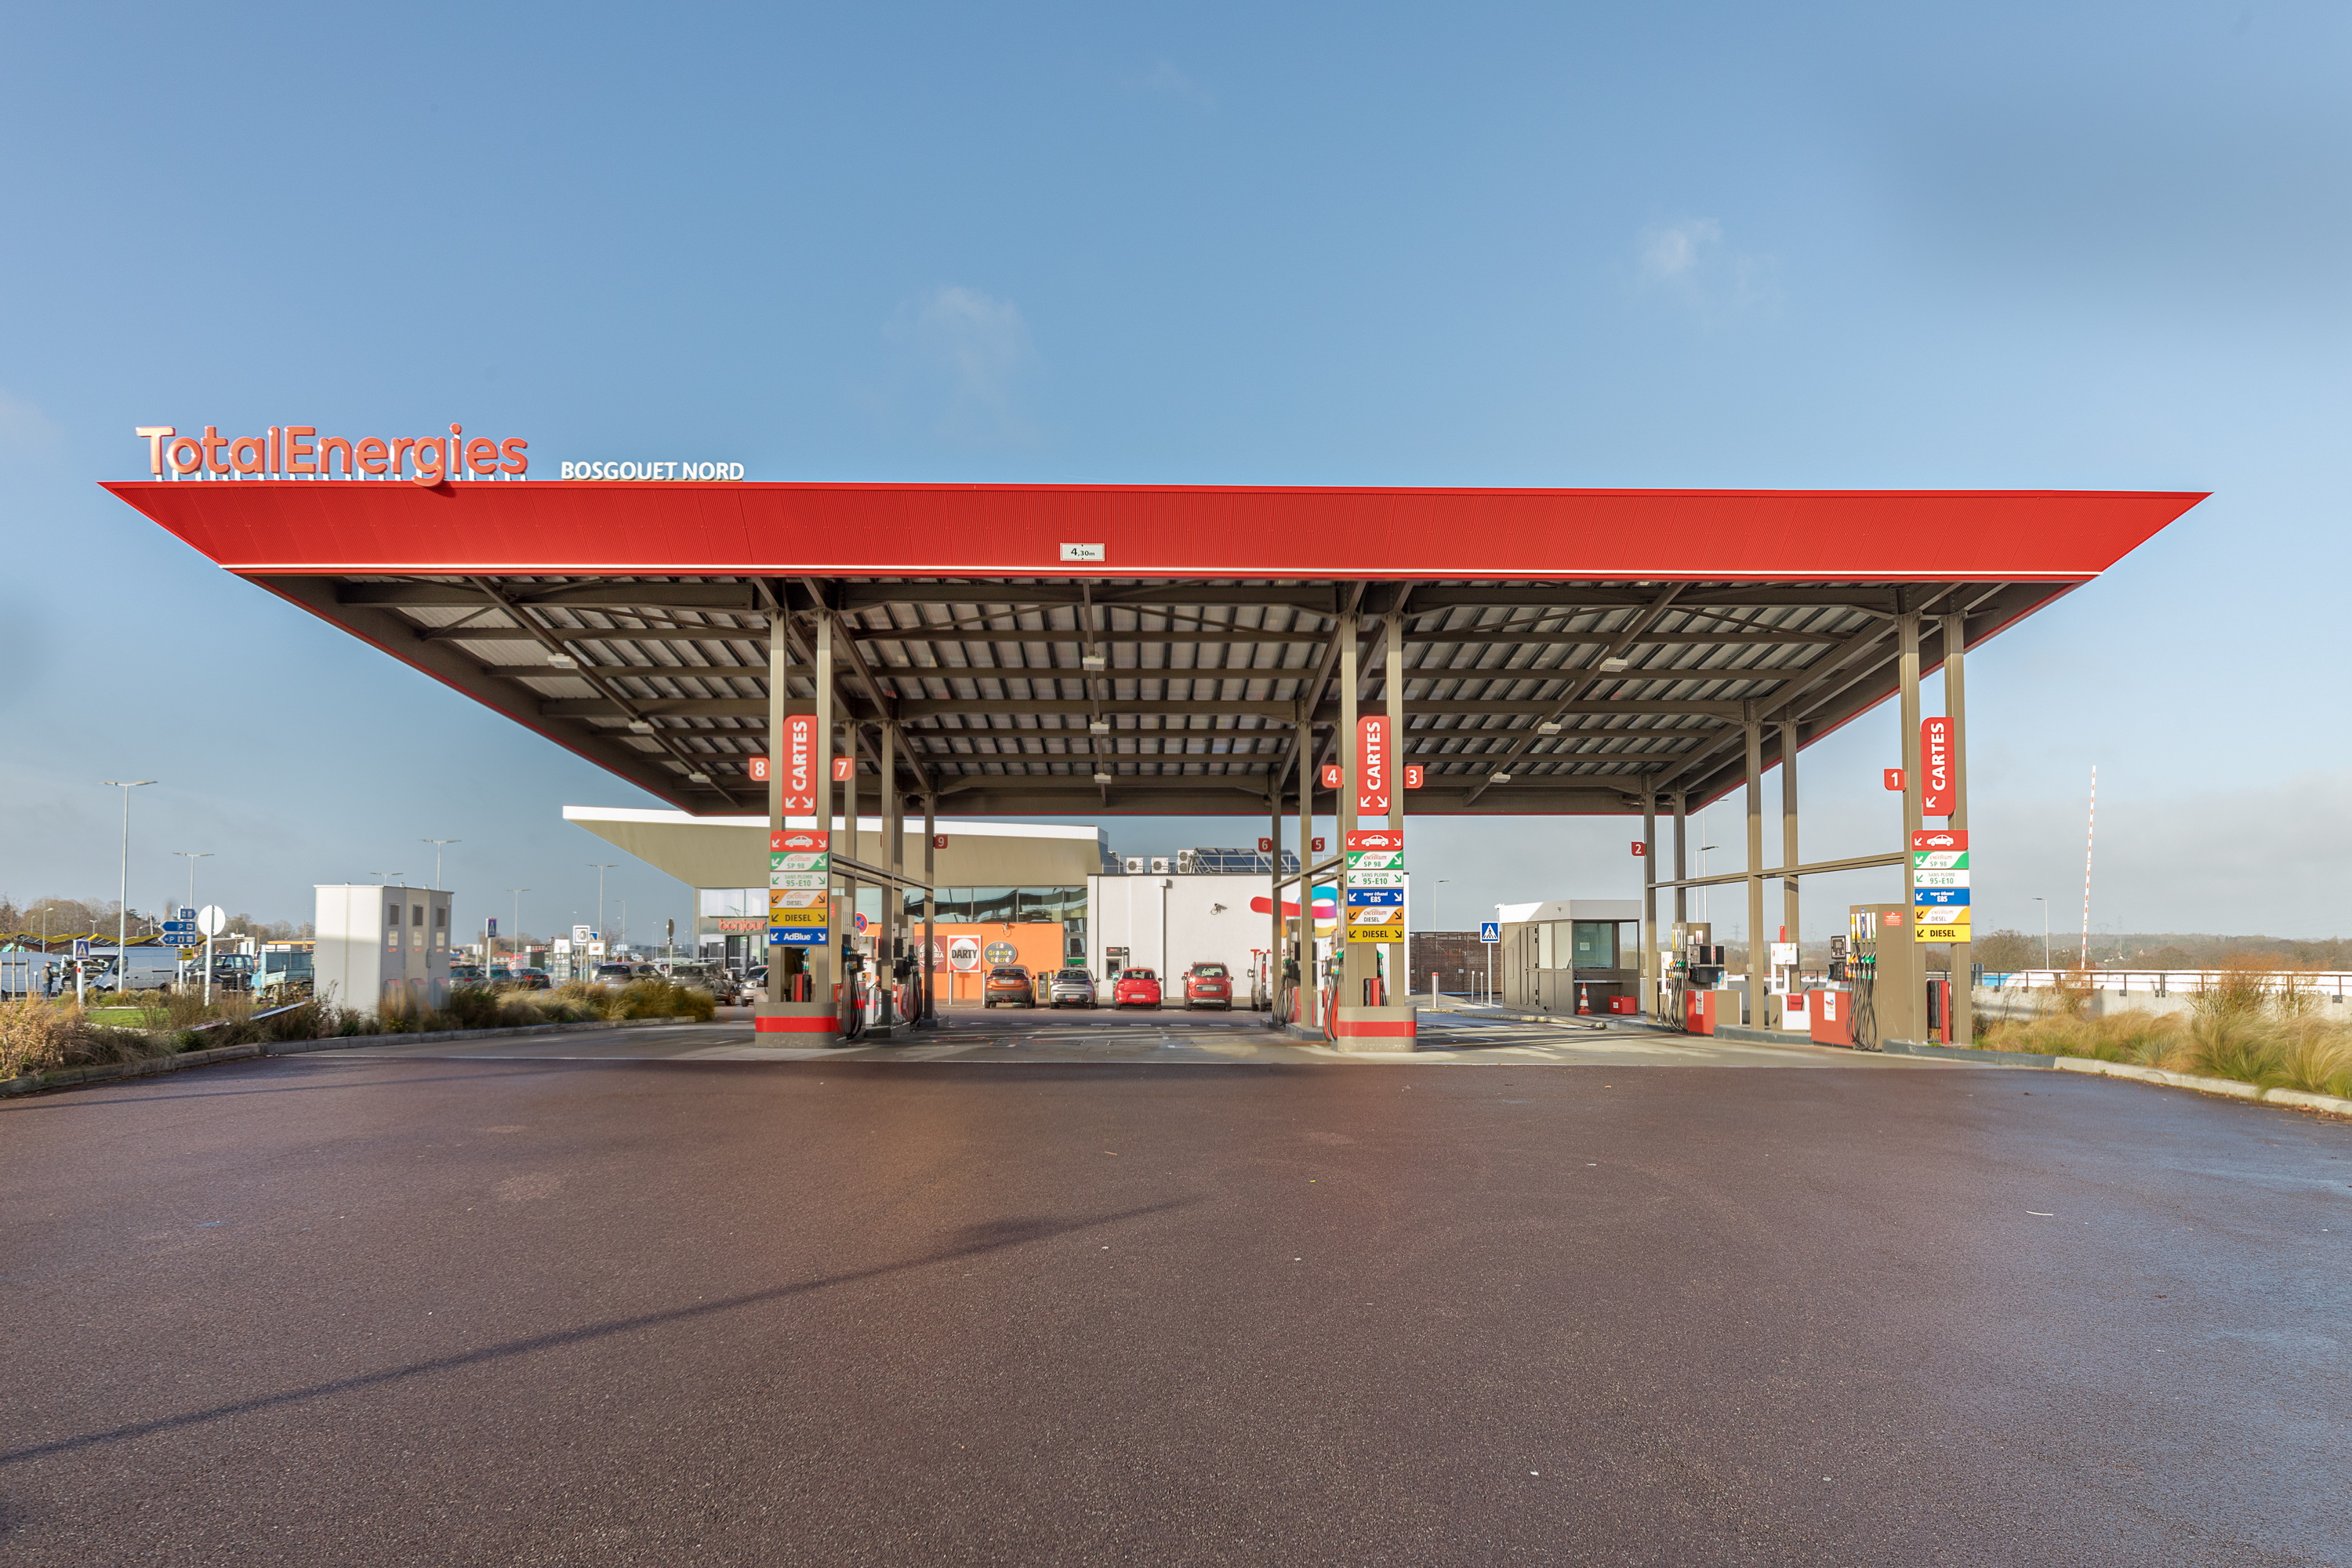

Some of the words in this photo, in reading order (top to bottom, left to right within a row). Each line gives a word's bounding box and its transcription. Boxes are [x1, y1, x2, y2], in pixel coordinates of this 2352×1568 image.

[136, 423, 529, 487] TotalEnergies
[561, 461, 679, 481] BOSGOUET
[682, 462, 745, 481] NORD
[1070, 547, 1095, 557] 4,30m
[793, 721, 808, 791] CARTES
[1367, 721, 1381, 790] CARTES
[1931, 722, 1946, 791] CARTES
[755, 761, 765, 777] 8
[838, 761, 848, 777] 7
[1327, 769, 1338, 784] 4
[1408, 769, 1417, 785] 3
[1891, 772, 1898, 787] 1
[938, 837, 945, 847] 9
[1261, 840, 1269, 851] 6
[1316, 839, 1322, 850] 5
[1635, 844, 1642, 855] 2
[718, 917, 766, 932] bonjour
[951, 949, 978, 959] DARTY
